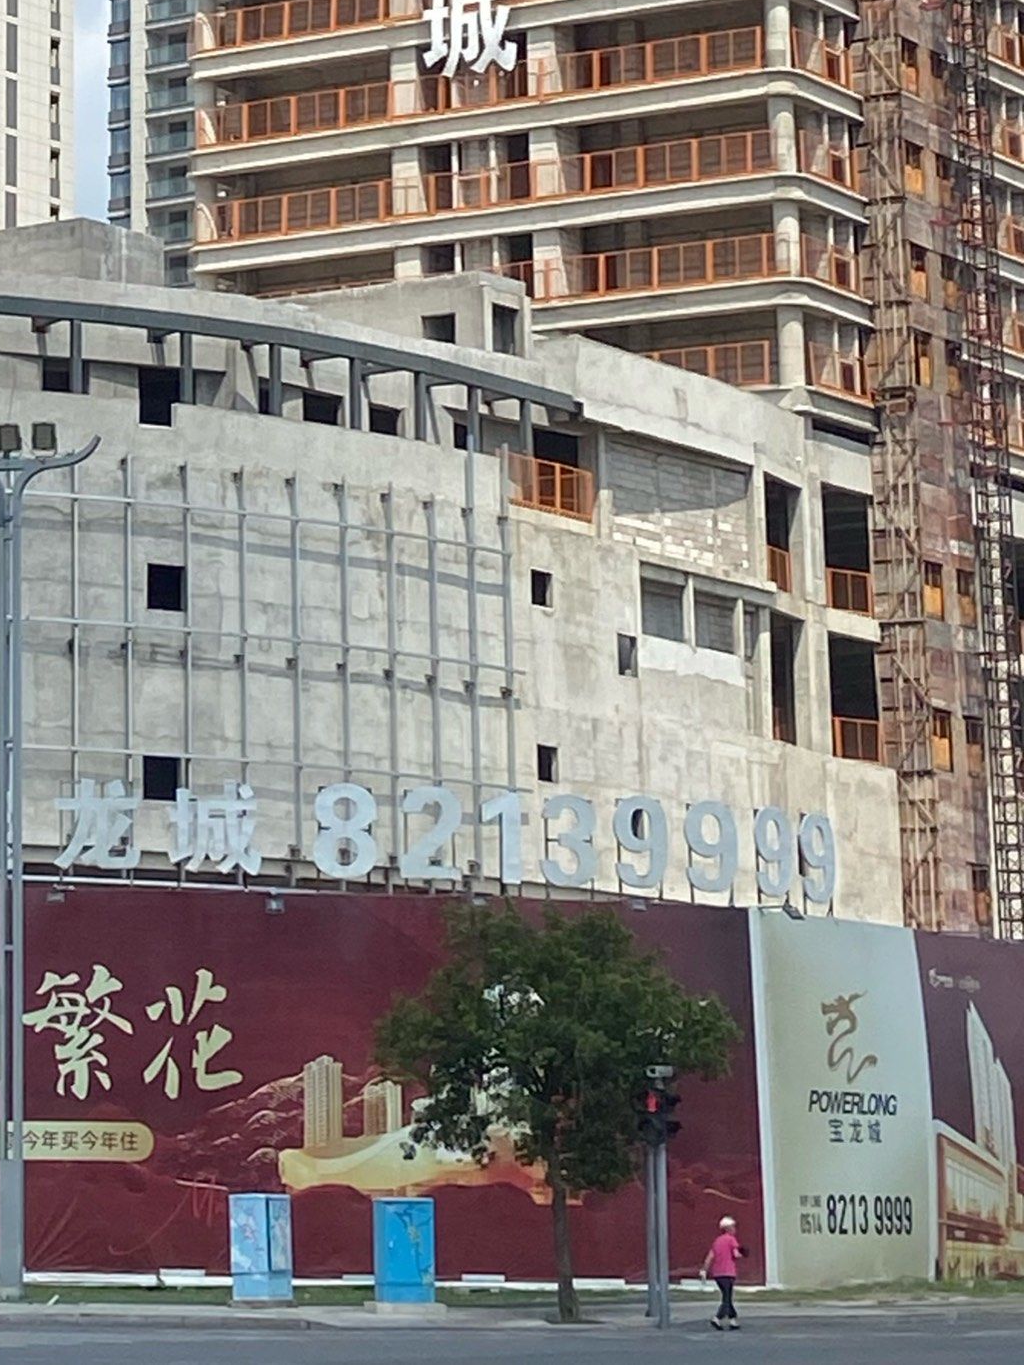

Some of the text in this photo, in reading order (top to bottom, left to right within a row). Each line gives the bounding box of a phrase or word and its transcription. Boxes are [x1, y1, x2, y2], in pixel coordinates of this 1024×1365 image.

[313, 783, 836, 903] 82139999
[808, 1090, 898, 1115] POWERLONG
[22, 1130, 139, 1151] 今年买今年住
[828, 1119, 883, 1143] 宝龙城
[827, 1194, 869, 1235] 8213
[874, 1196, 913, 1236] 9999
